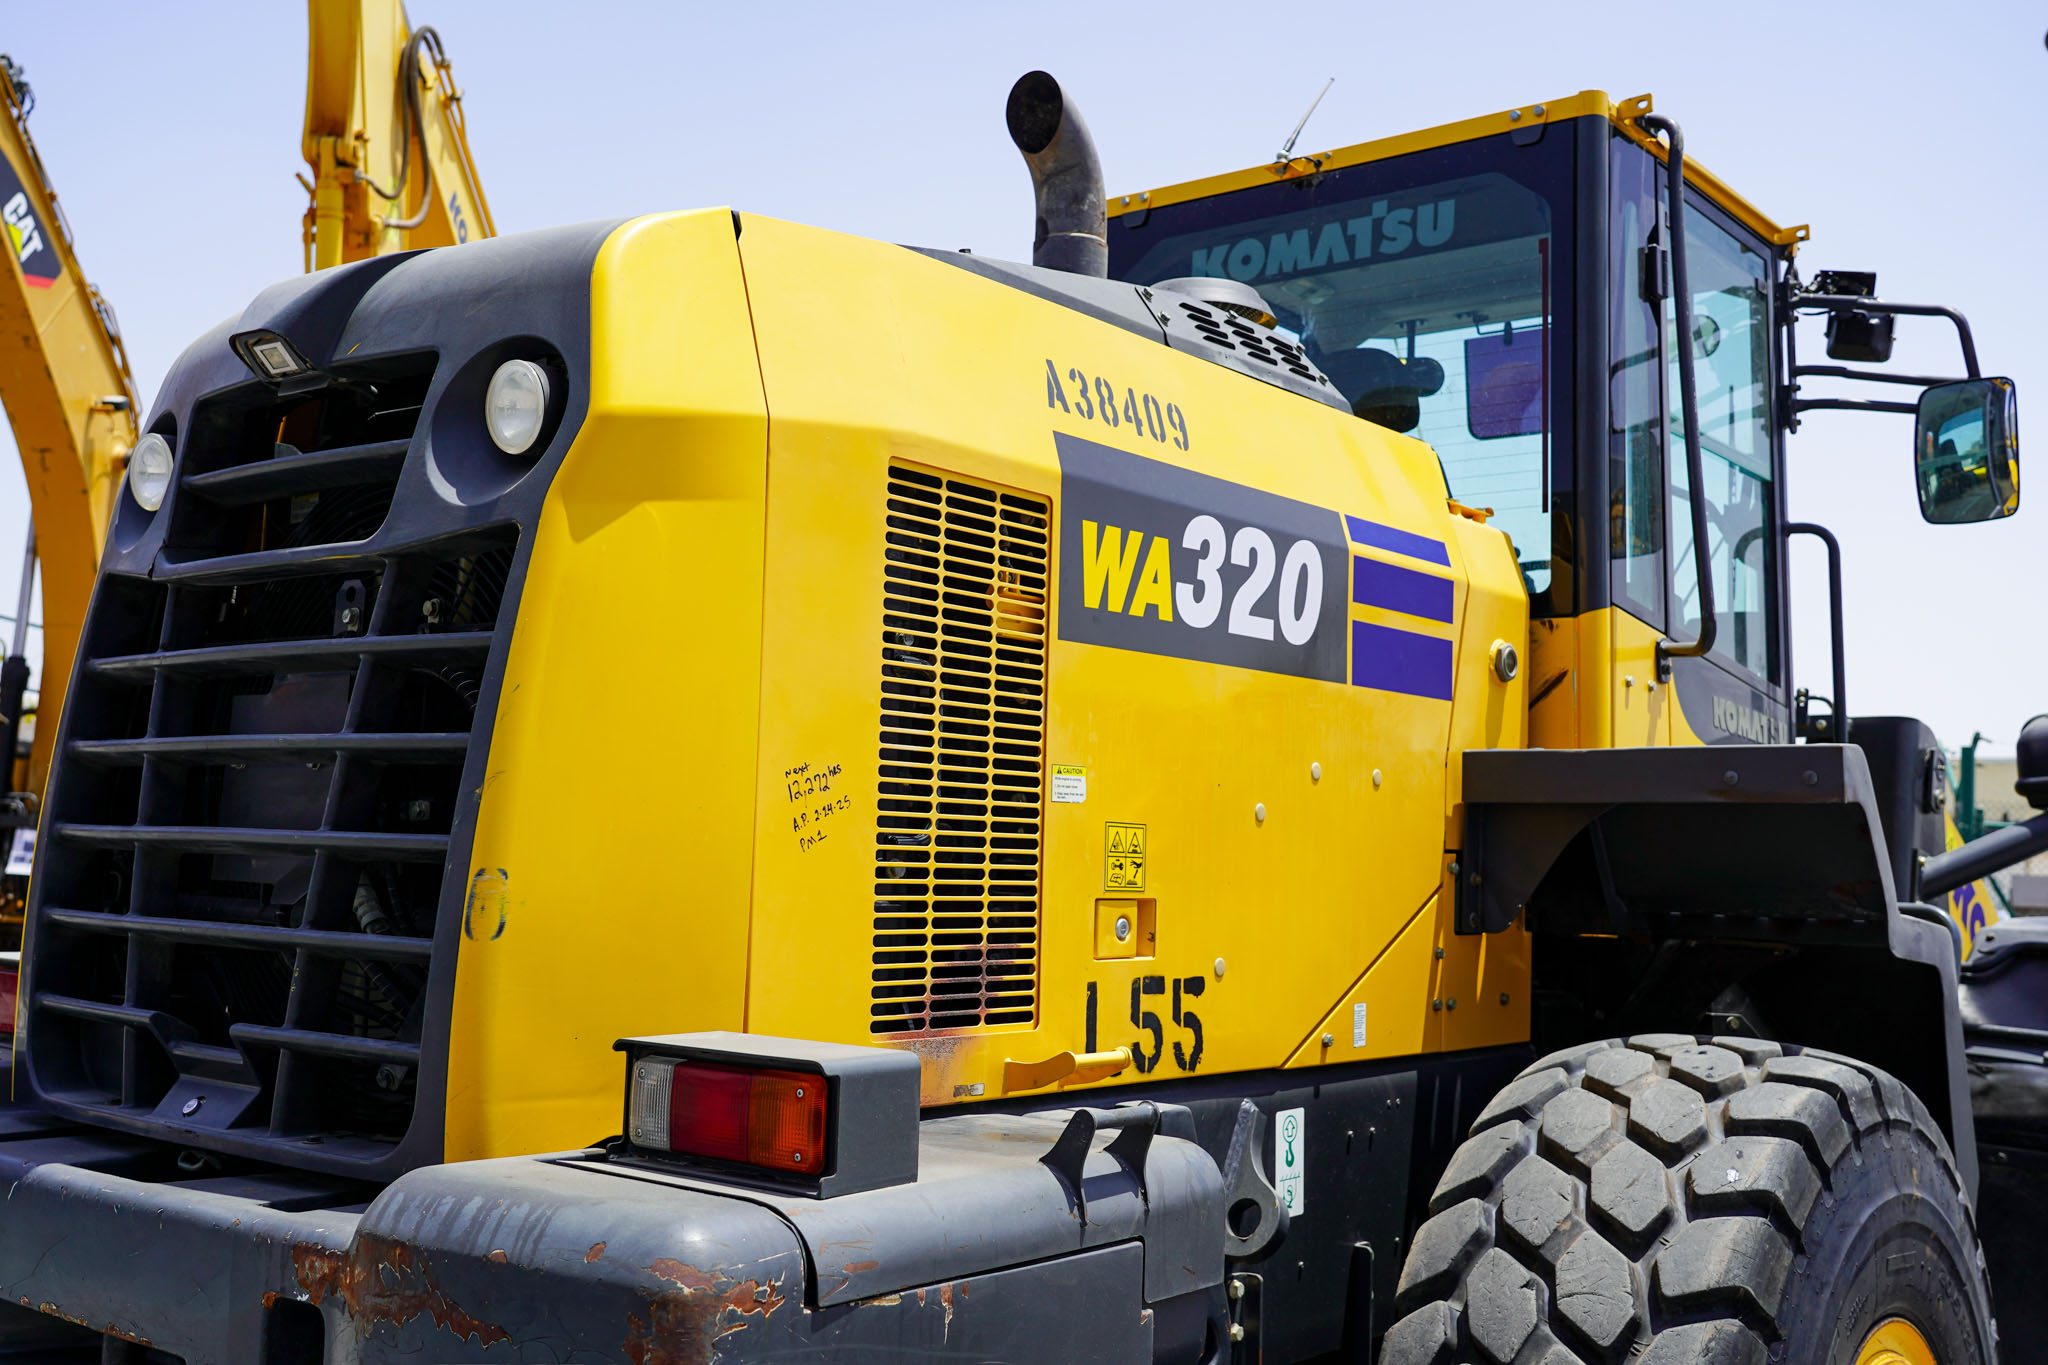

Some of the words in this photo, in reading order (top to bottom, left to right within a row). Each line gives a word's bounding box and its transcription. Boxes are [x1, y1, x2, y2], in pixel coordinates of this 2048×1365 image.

[3, 192, 44, 263] CAT
[1191, 200, 1456, 282] KOMATSU
[1045, 359, 1190, 451] A38409
[1082, 515, 1324, 645] WA320
[1712, 695, 1788, 745] KOMATSU
[1062, 767, 1084, 775] CAUTION
